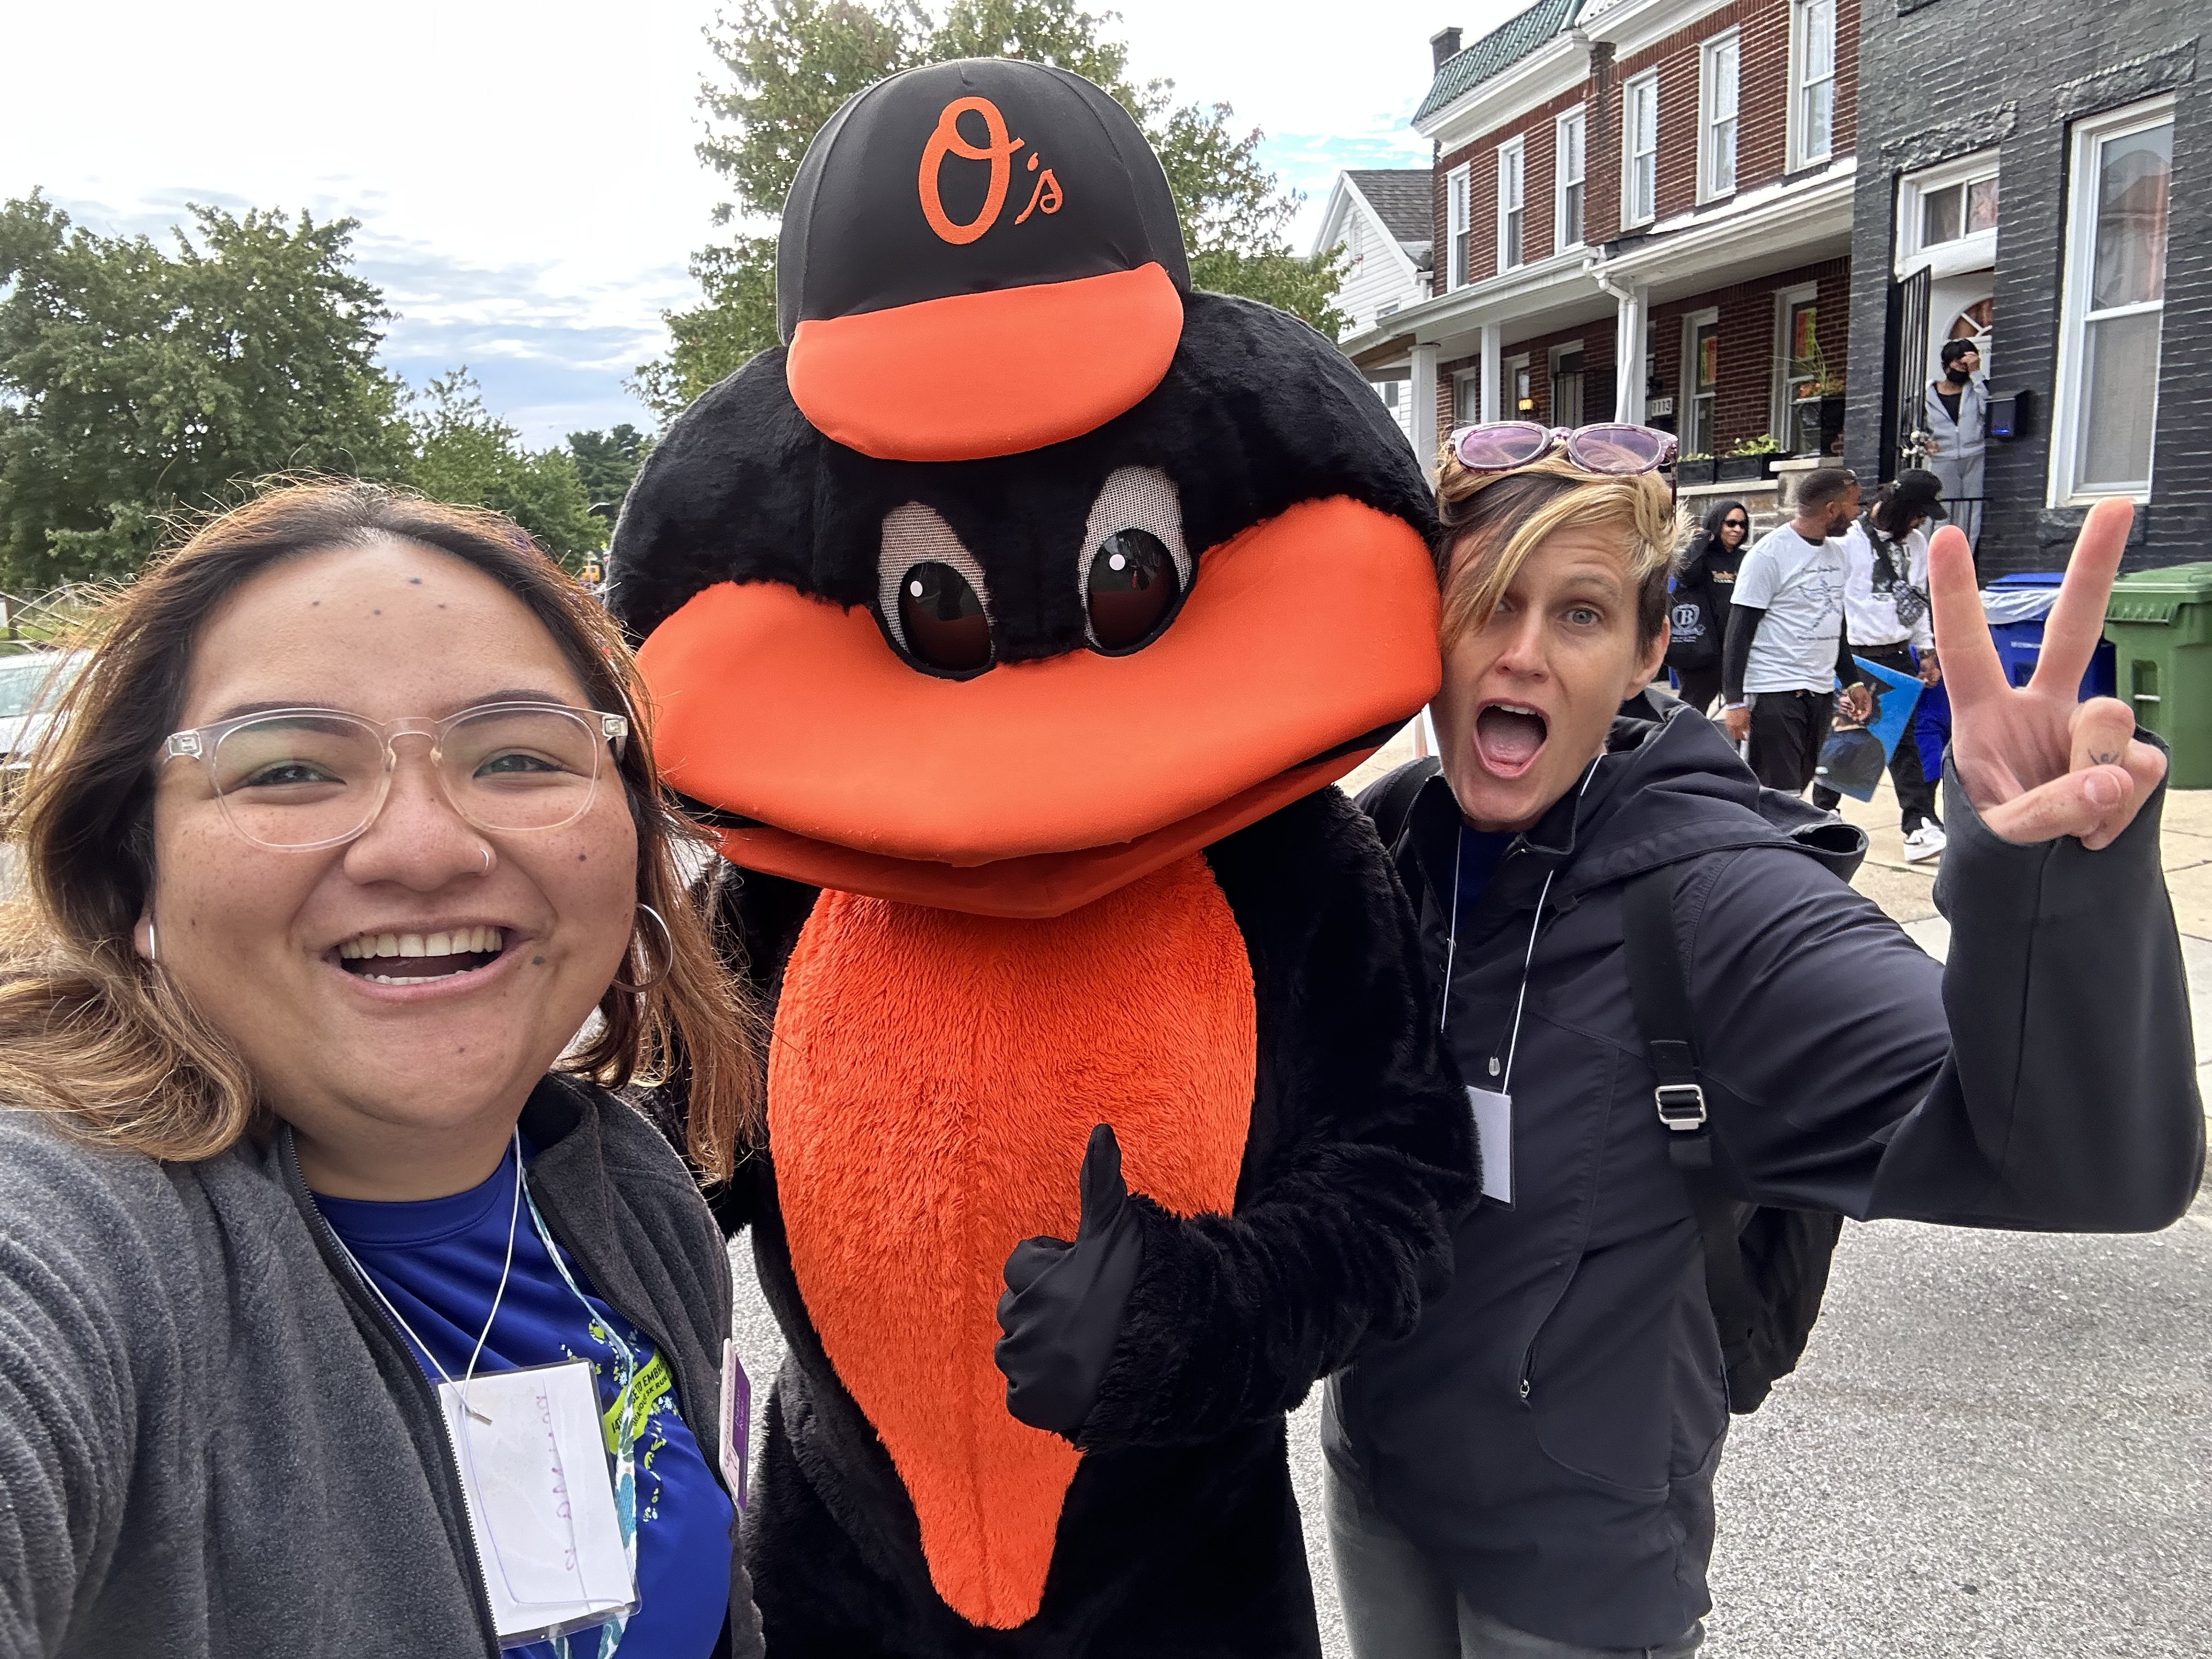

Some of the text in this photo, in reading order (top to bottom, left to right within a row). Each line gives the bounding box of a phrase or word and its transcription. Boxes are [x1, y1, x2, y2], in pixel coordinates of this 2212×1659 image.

[918, 96, 1063, 245] O's
[635, 1381, 642, 1394] TO
[642, 1361, 663, 1387] EMBR
[646, 1386, 654, 1397] 5K
[655, 1374, 667, 1390] RUN
